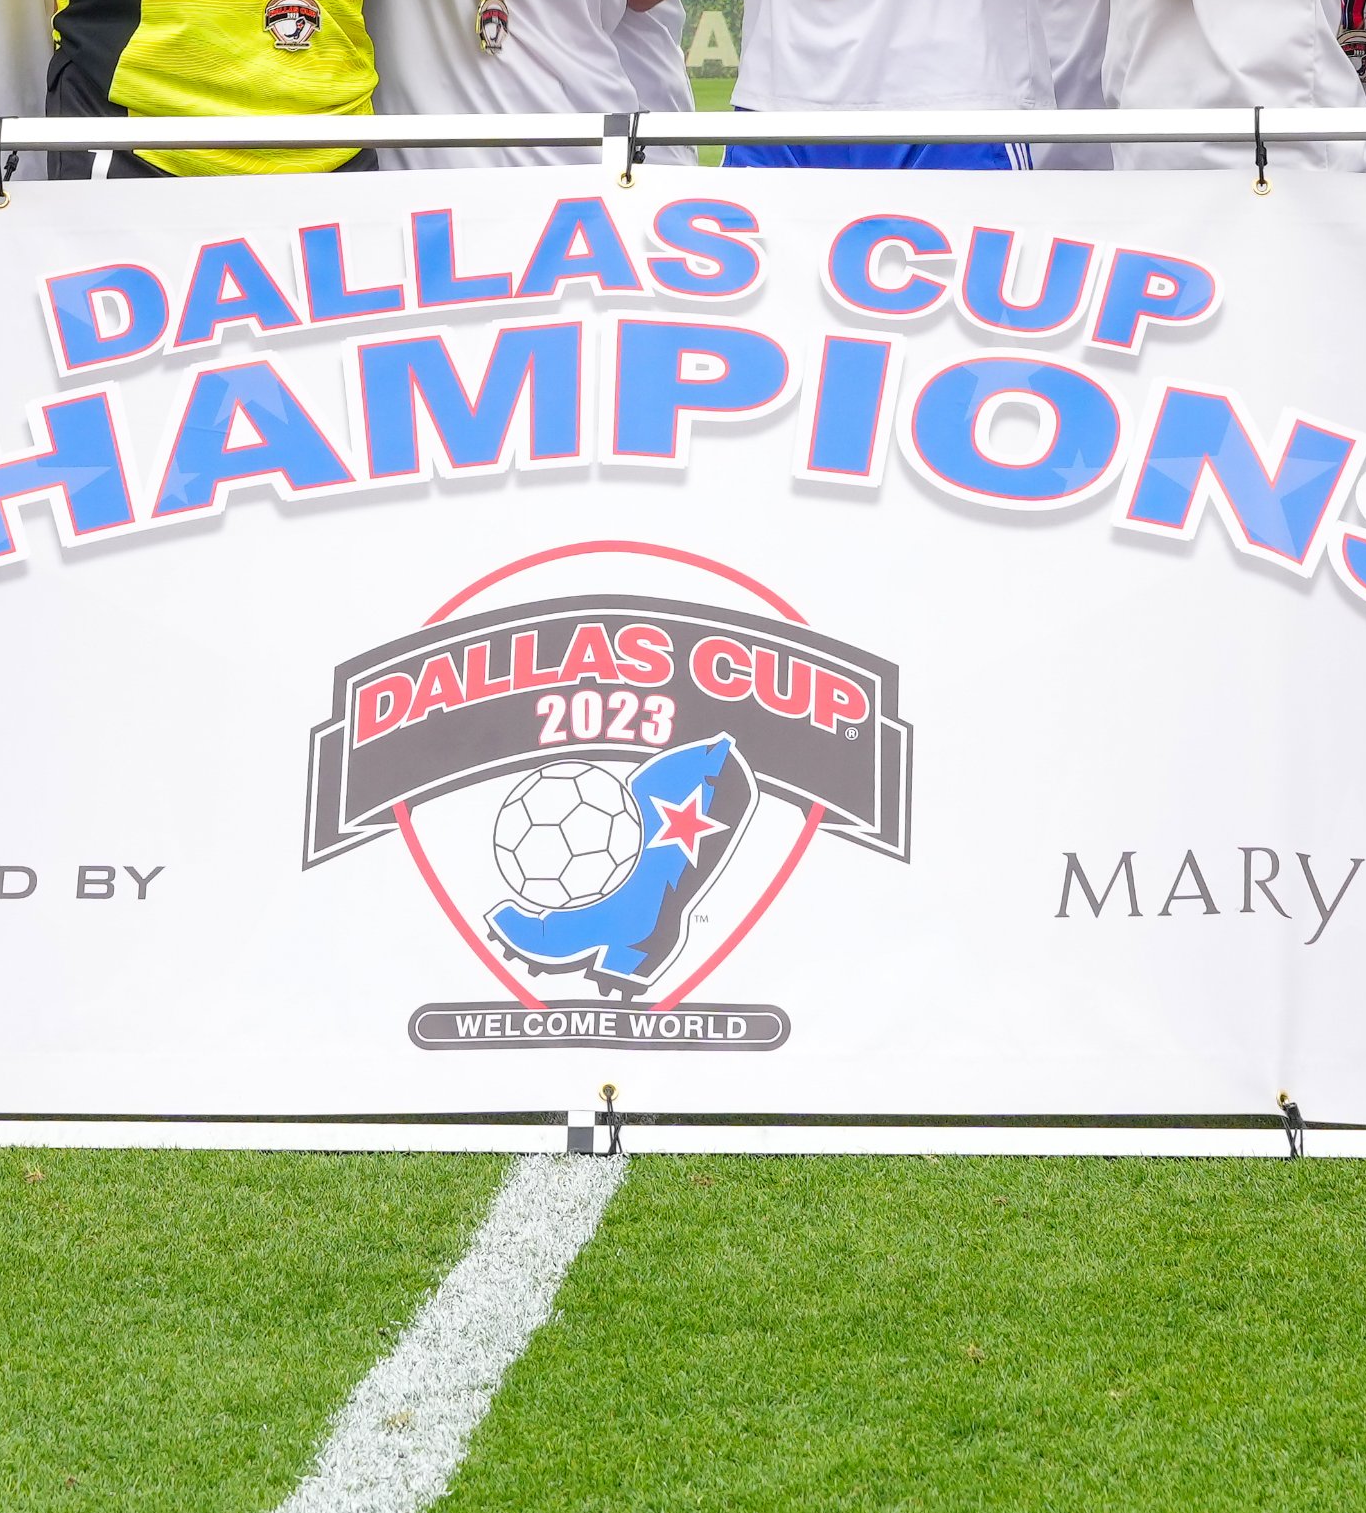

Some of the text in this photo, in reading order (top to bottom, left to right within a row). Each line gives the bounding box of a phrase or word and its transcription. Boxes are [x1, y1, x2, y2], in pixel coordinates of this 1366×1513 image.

[46, 195, 1216, 371] DALLAS CUP
[351, 621, 869, 750] DALLAS CUP
[536, 689, 676, 746] 2023
[75, 865, 166, 901] BY
[1054, 846, 1365, 946] MARY
[455, 1012, 747, 1040] WELCOME WORLD
